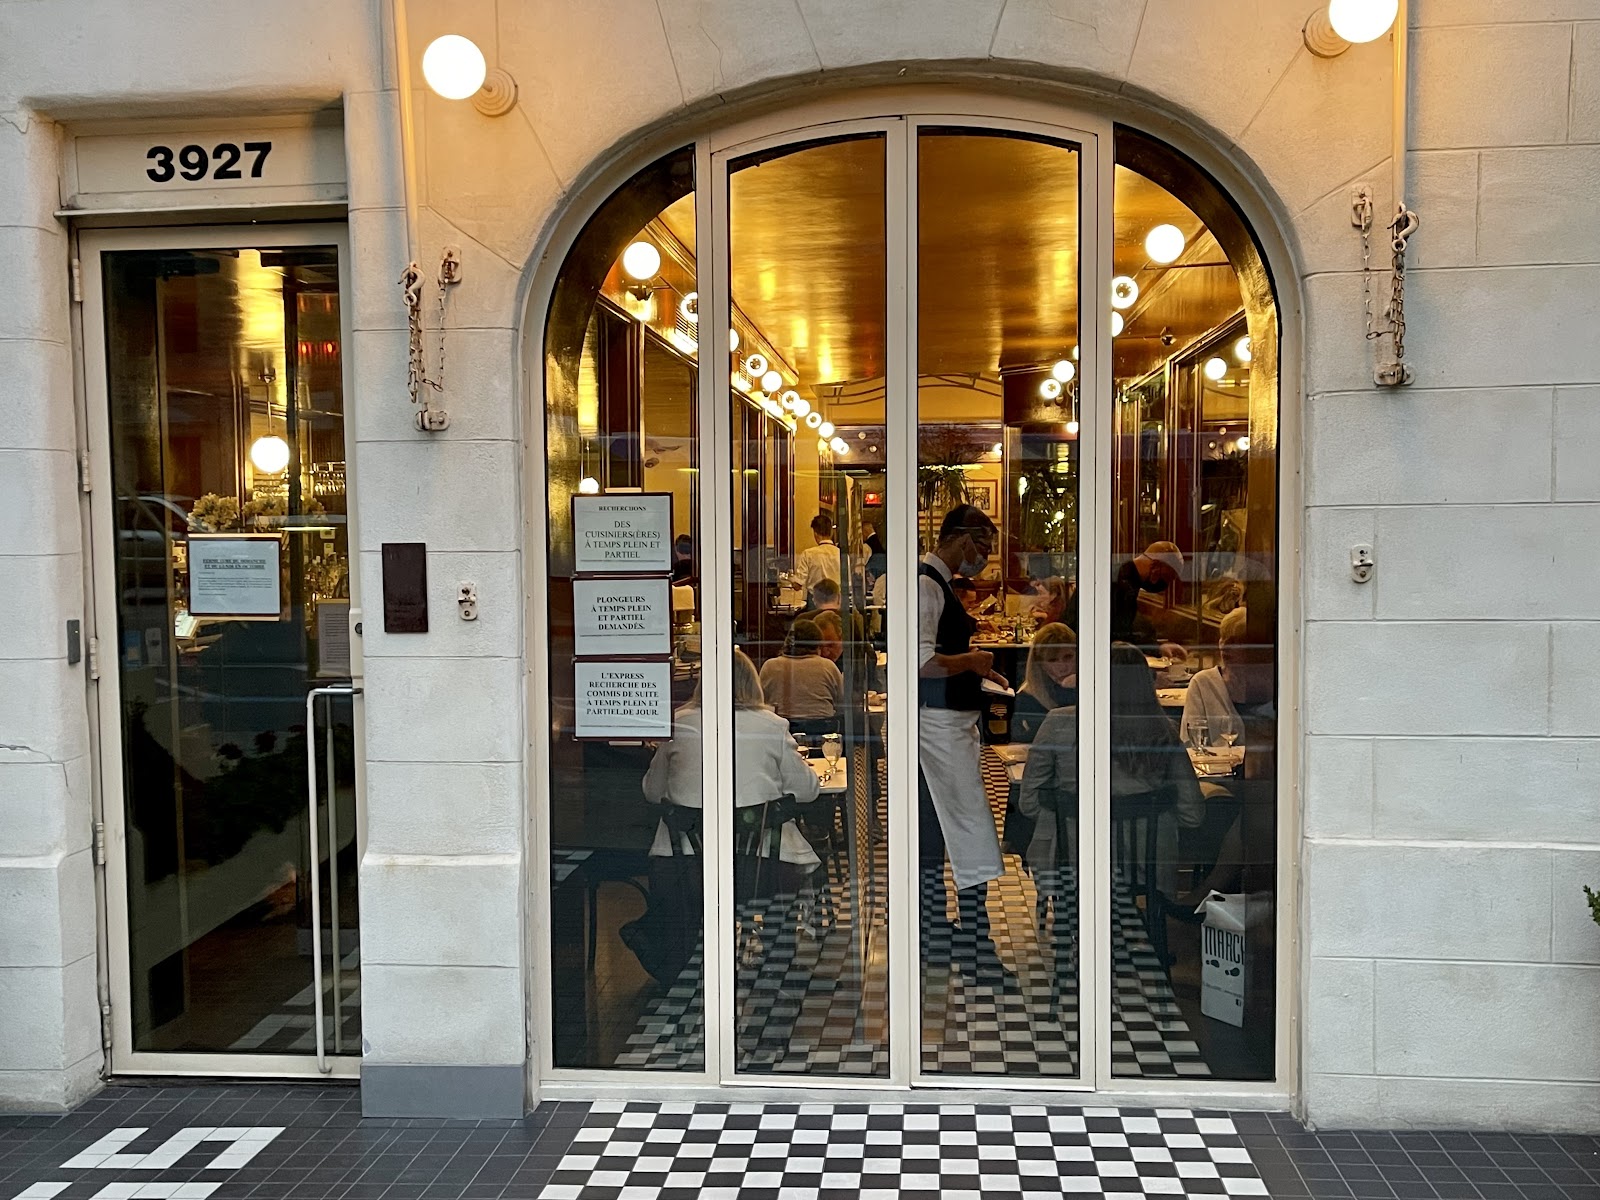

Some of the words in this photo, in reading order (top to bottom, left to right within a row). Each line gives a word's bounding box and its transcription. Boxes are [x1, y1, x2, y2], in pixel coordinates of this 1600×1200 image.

[146, 141, 272, 183] 3927
[614, 520, 631, 528] DES
[585, 540, 591, 548] À
[591, 604, 597, 612] À
[598, 622, 645, 630] DEMANDÉS.
[587, 698, 592, 706] À
